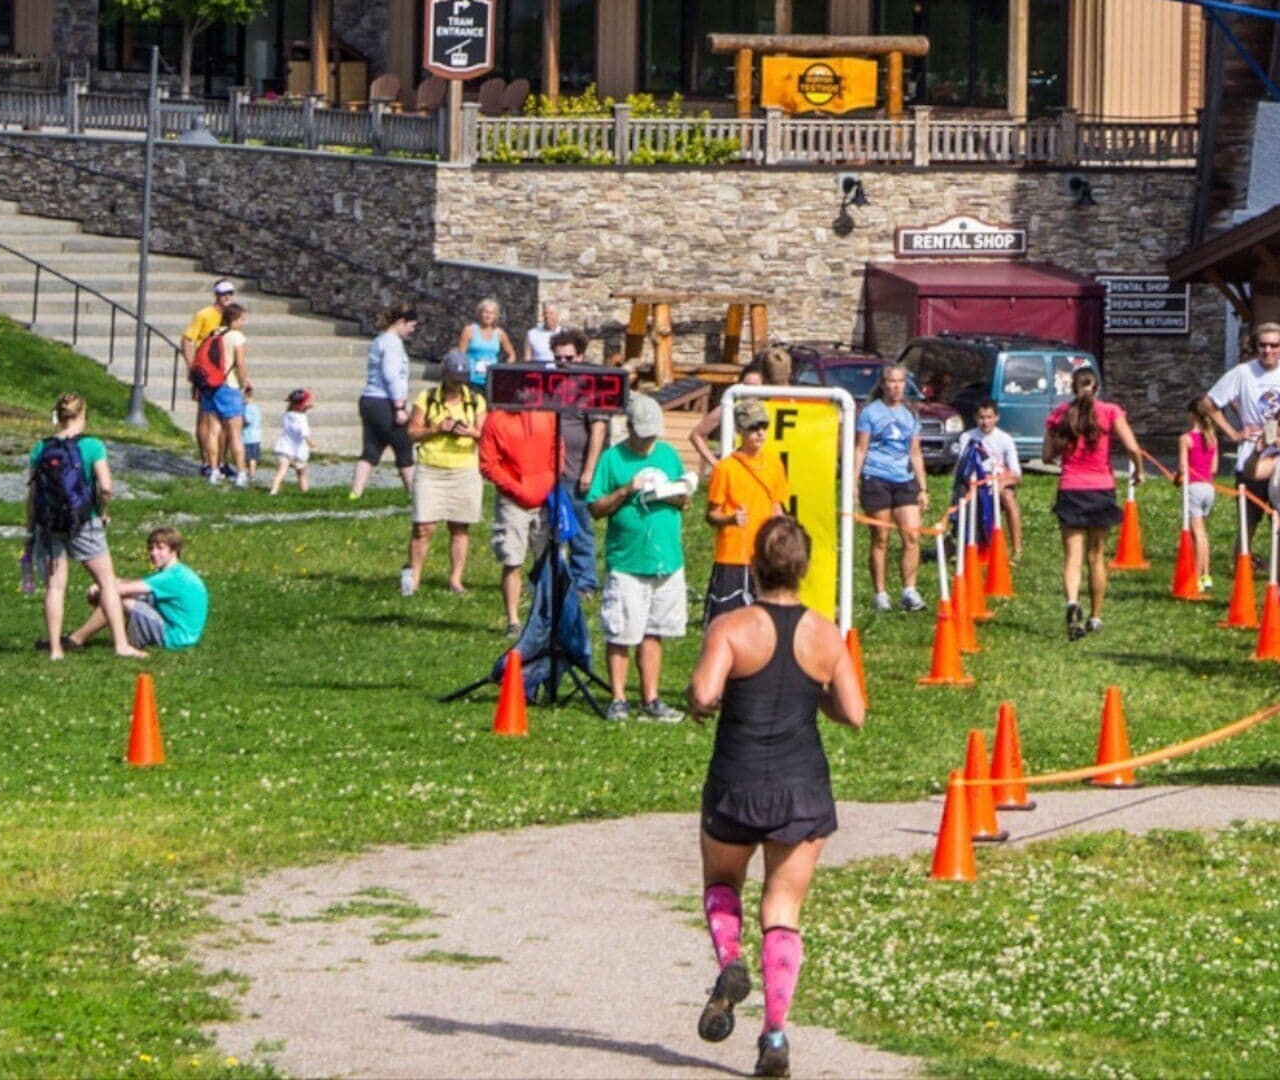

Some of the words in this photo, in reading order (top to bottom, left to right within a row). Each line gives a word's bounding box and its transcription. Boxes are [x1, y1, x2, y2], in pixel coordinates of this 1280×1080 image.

[448, 16, 473, 26] TRAM
[436, 26, 484, 37] ENTRANCE
[913, 234, 970, 249] RENTAL
[974, 234, 1015, 249] SHOP
[1111, 282, 1144, 292] RENTAL
[1146, 282, 1169, 292] SHOP
[1111, 300, 1141, 310] REPAIR
[1143, 300, 1166, 309] SHOP
[1111, 318, 1143, 327] RENTAL
[1144, 318, 1184, 328] RETURNS
